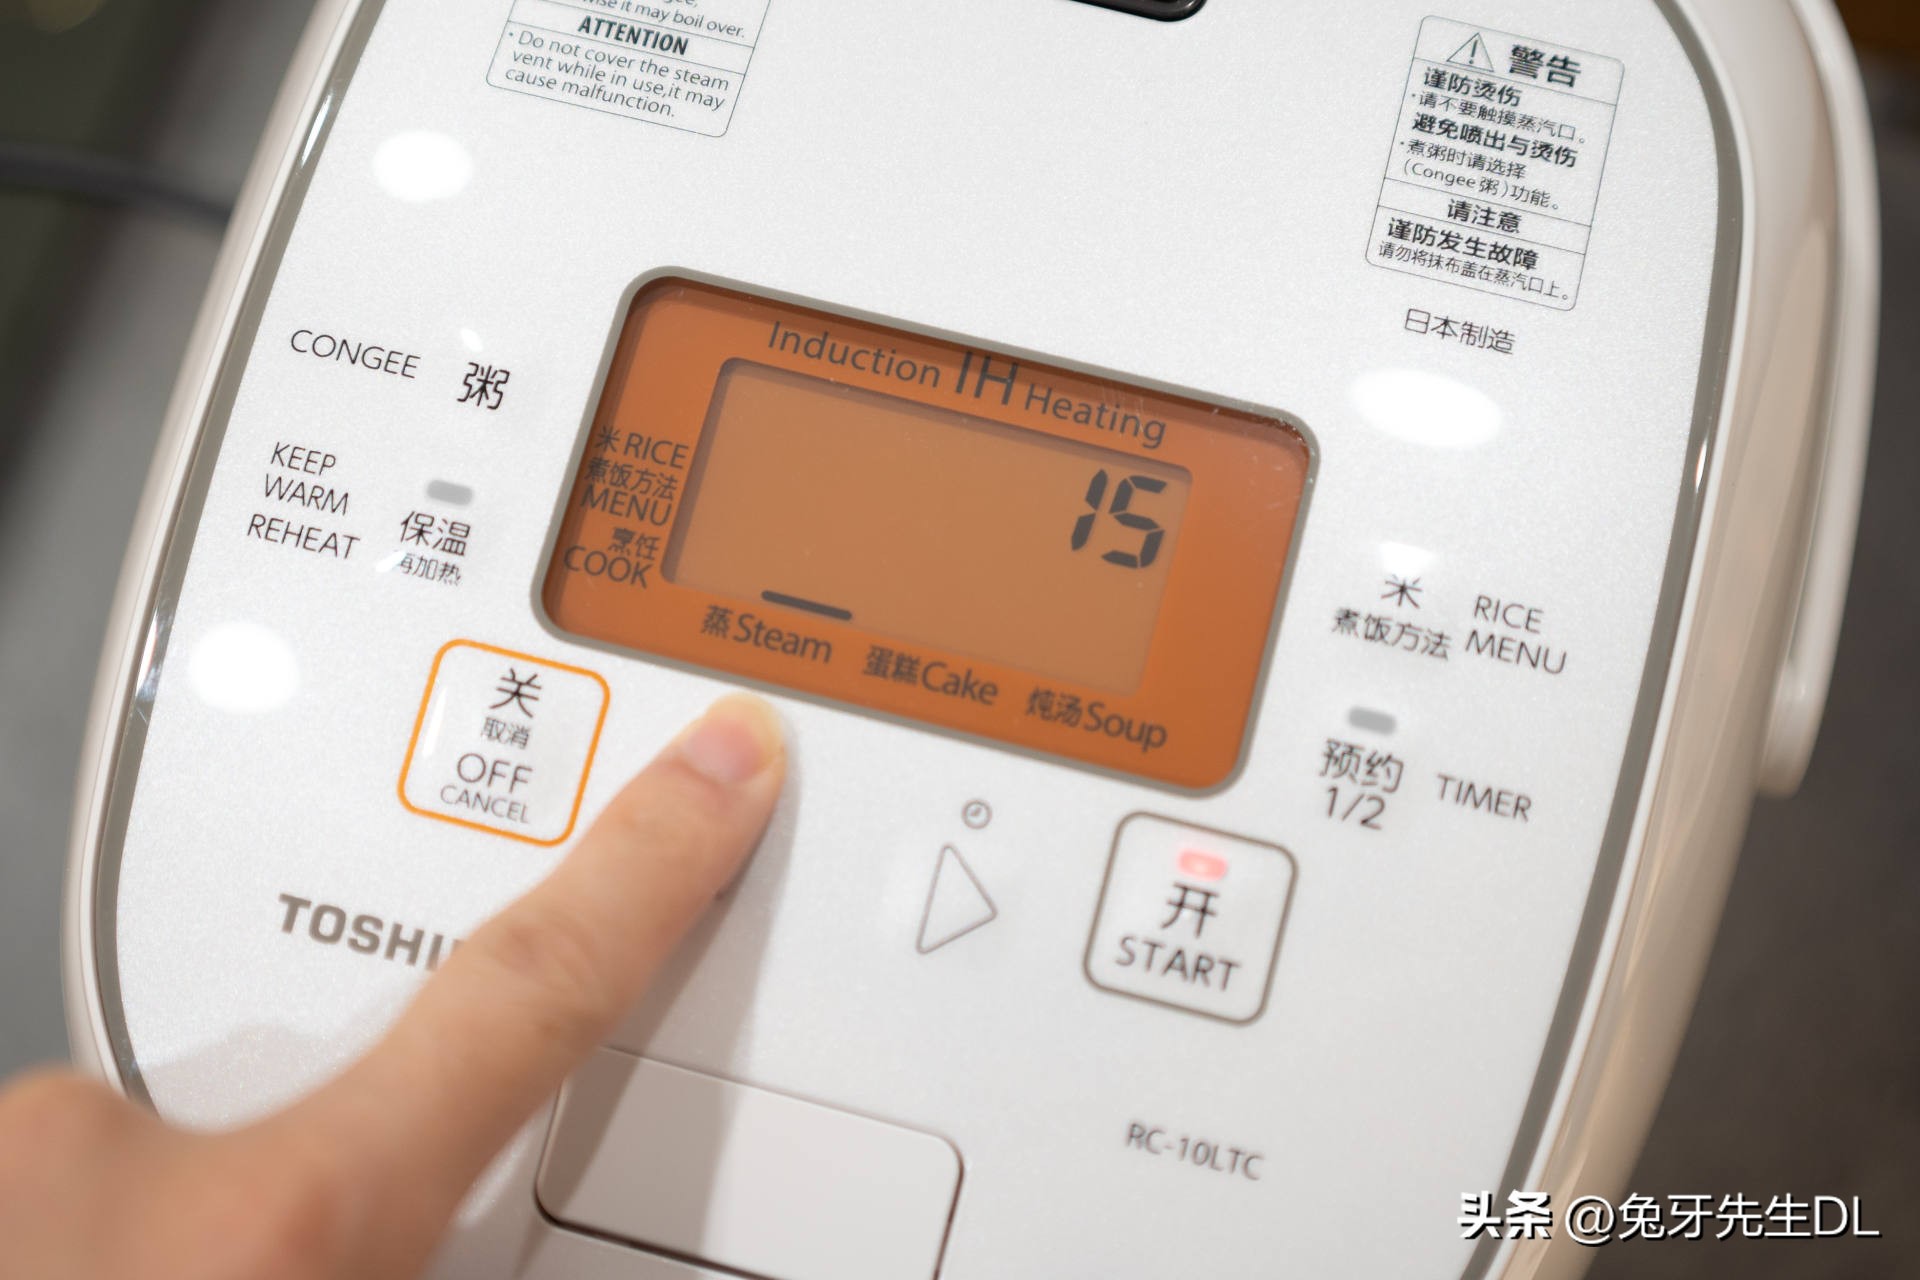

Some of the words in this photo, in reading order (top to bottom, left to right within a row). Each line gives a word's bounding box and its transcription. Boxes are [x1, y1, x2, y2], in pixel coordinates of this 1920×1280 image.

[577, 15, 689, 56] ATTENTION
[621, 0, 631, 12] it
[635, 3, 671, 23] may
[673, 9, 705, 28] boil
[706, 20, 745, 39] over.
[513, 50, 553, 70] vent
[558, 60, 606, 82] while
[610, 71, 627, 87] in
[632, 78, 680, 99] use,it
[685, 90, 725, 111] may
[518, 30, 544, 49] Do
[549, 40, 581, 57] not
[584, 48, 636, 69] cover
[640, 58, 669, 77] the
[673, 68, 729, 91] steam
[1508, 43, 1582, 88] 警告
[505, 68, 557, 90] cause
[561, 81, 675, 118] malfunction.
[1423, 66, 1522, 108] 谨防烫伤
[1412, 111, 1579, 169] 避免喷出与烫伤
[1418, 91, 1587, 144] 请不要触摸蒸汽口。
[1406, 138, 1528, 181] 煮粥时请选择
[1446, 198, 1523, 234] 请注意
[1387, 216, 1539, 271] 谨防发生故障
[1379, 240, 1568, 302] 请勿将抹布盖在蒸汽口上。
[290, 329, 420, 379] CONGEE
[1404, 308, 1516, 355] 日本制造
[456, 362, 511, 410] 粥
[768, 321, 941, 389] Induction
[955, 351, 1020, 406] IH
[1024, 382, 1167, 450] Heating
[270, 441, 336, 476] KEEP
[595, 425, 621, 453] 米
[623, 432, 690, 470] RICE
[264, 473, 349, 516] WARM
[584, 456, 678, 501] 煮饭方法
[579, 484, 673, 527] MENU
[1070, 468, 1167, 569] 15
[247, 513, 361, 560] REHEAT
[400, 510, 471, 557] 保温
[607, 527, 661, 561] 烹饪
[563, 545, 654, 589] COOK
[1381, 573, 1423, 609] 米
[1474, 594, 1545, 634] RICE
[1331, 607, 1451, 661] 煮饭方法
[1465, 629, 1568, 675] MENU
[489, 667, 543, 719] 关
[480, 715, 532, 751] 取消
[456, 752, 534, 794] OFF
[1319, 737, 1405, 794] 预约
[439, 784, 531, 825] CANCEL
[1326, 786, 1387, 831] 1/2
[1437, 773, 1533, 824] TIMER
[278, 892, 468, 972] TOSHI
[1161, 881, 1220, 939] 开
[1114, 935, 1242, 992] START
[1125, 1121, 1264, 1182] RC-10LTC
